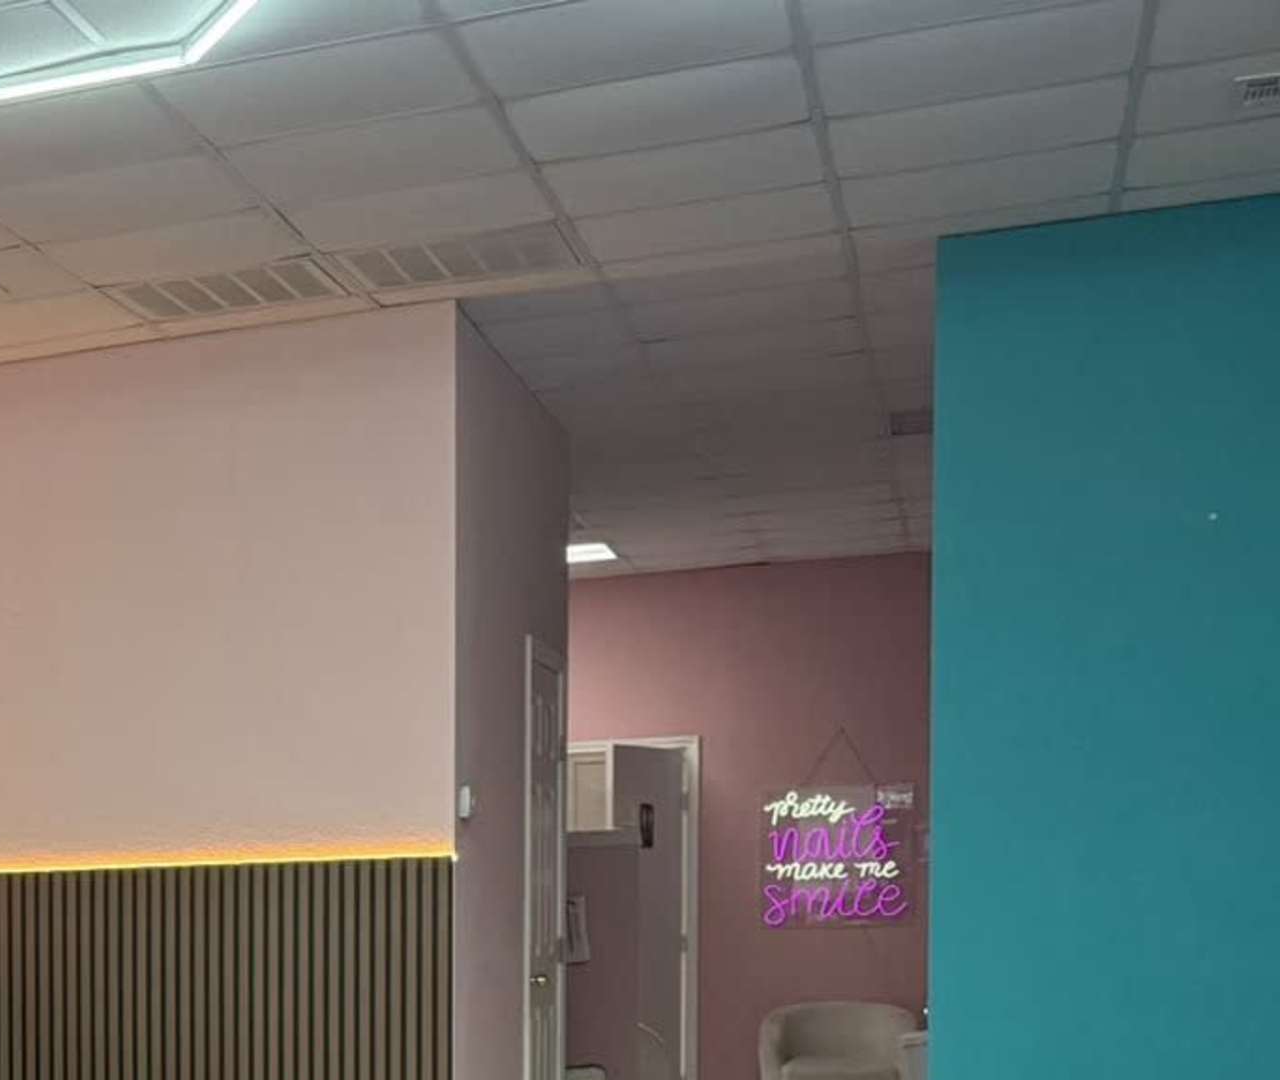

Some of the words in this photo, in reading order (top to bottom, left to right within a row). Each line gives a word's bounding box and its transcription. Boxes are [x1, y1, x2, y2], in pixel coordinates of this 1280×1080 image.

[763, 791, 856, 826] pretty
[768, 804, 900, 863] nails
[765, 861, 848, 880] make
[854, 860, 899, 879] me
[763, 877, 908, 926] smile
